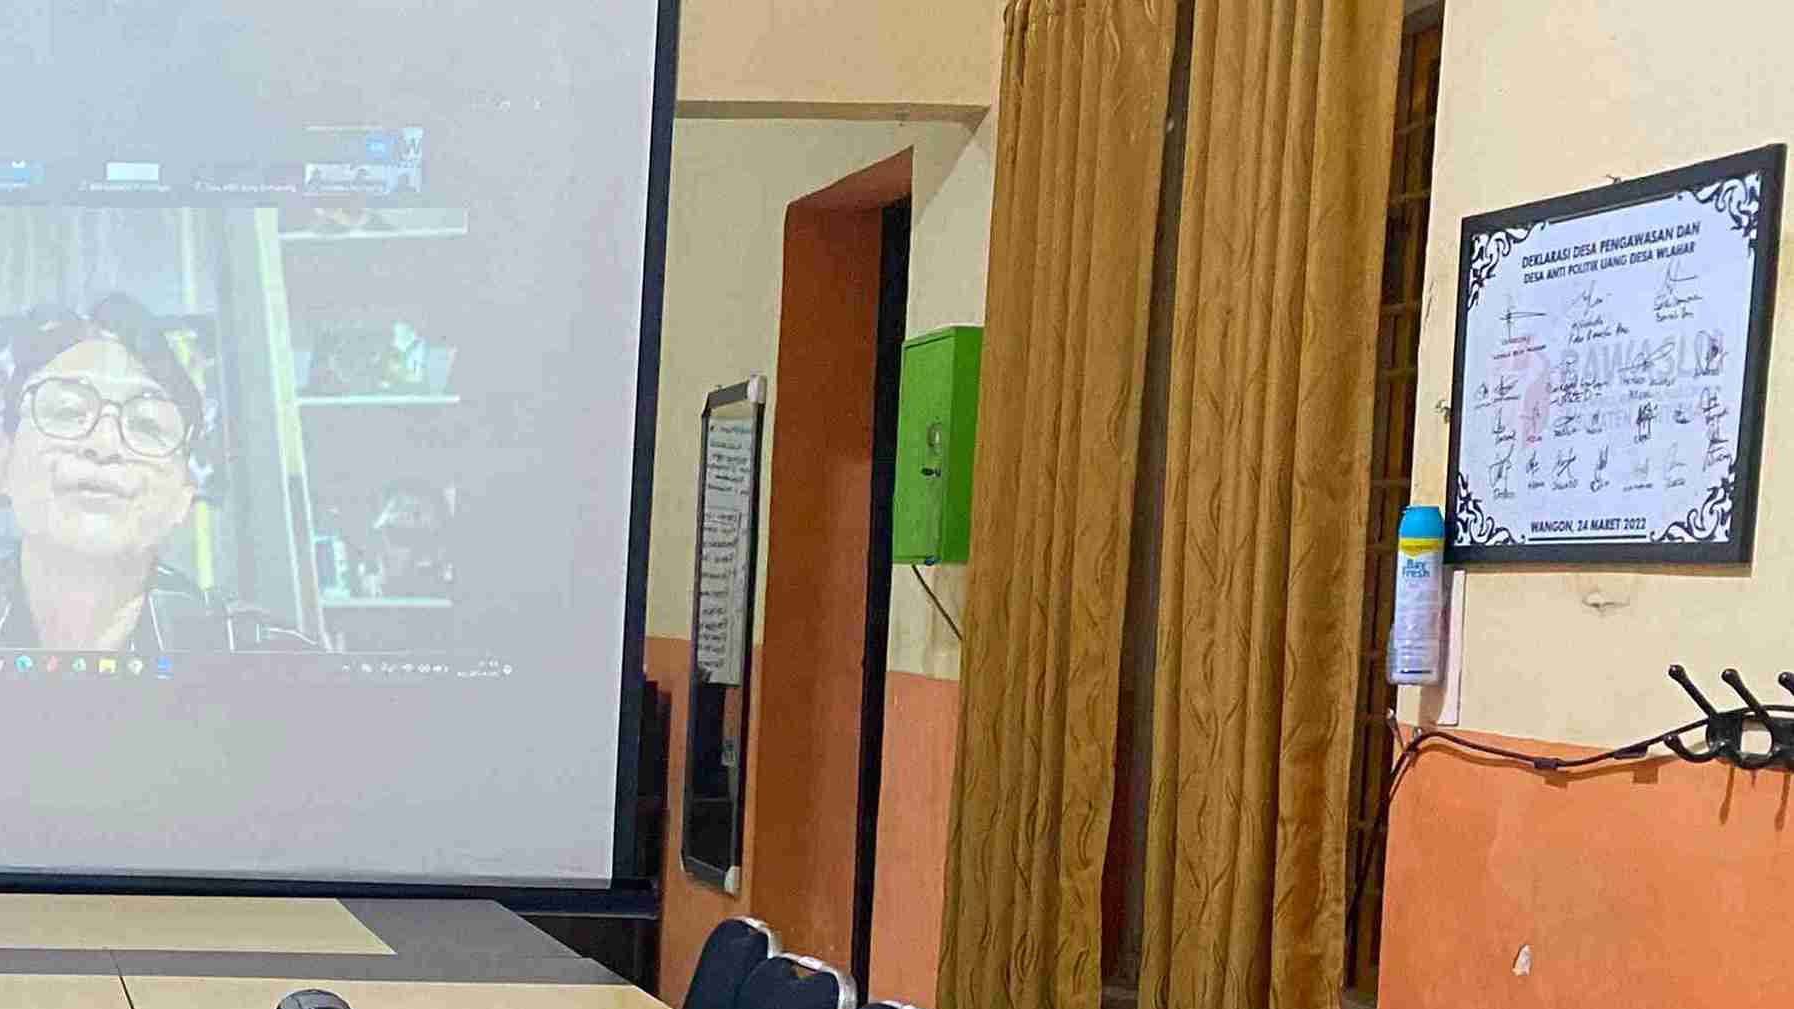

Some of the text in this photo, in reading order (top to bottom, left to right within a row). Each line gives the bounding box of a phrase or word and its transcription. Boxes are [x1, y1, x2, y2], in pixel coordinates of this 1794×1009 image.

[1521, 220, 1702, 269] DEKLARASI DESA PENGAWASAN DAN
[1523, 240, 1696, 284] DESA ANTI POLITIK UANG DESA WLAHAR
[1591, 518, 1621, 531] MARET
[1624, 517, 1647, 530] 2022
